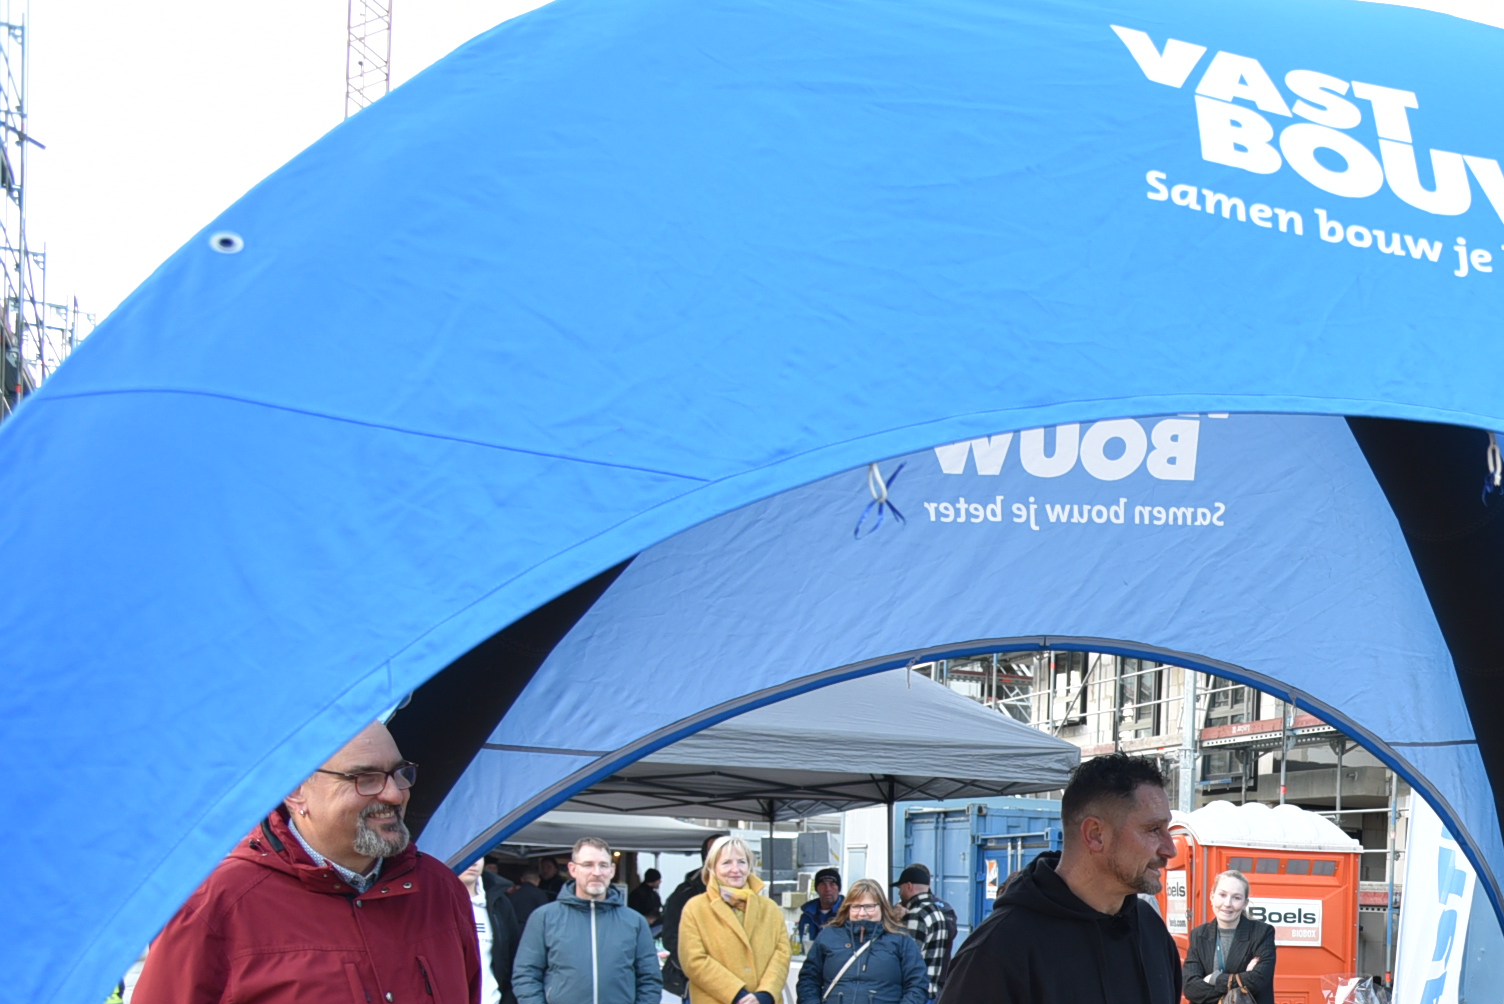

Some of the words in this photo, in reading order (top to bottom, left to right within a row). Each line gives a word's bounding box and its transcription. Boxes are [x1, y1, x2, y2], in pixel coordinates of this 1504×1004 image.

[1109, 24, 1419, 144] VAST
[1146, 169, 1304, 236] Samen
[1313, 208, 1443, 263] bouw
[1453, 237, 1493, 278] je
[1167, 881, 1186, 897] oels
[1249, 907, 1317, 924] Boels
[1291, 929, 1316, 938] BIOBOX
